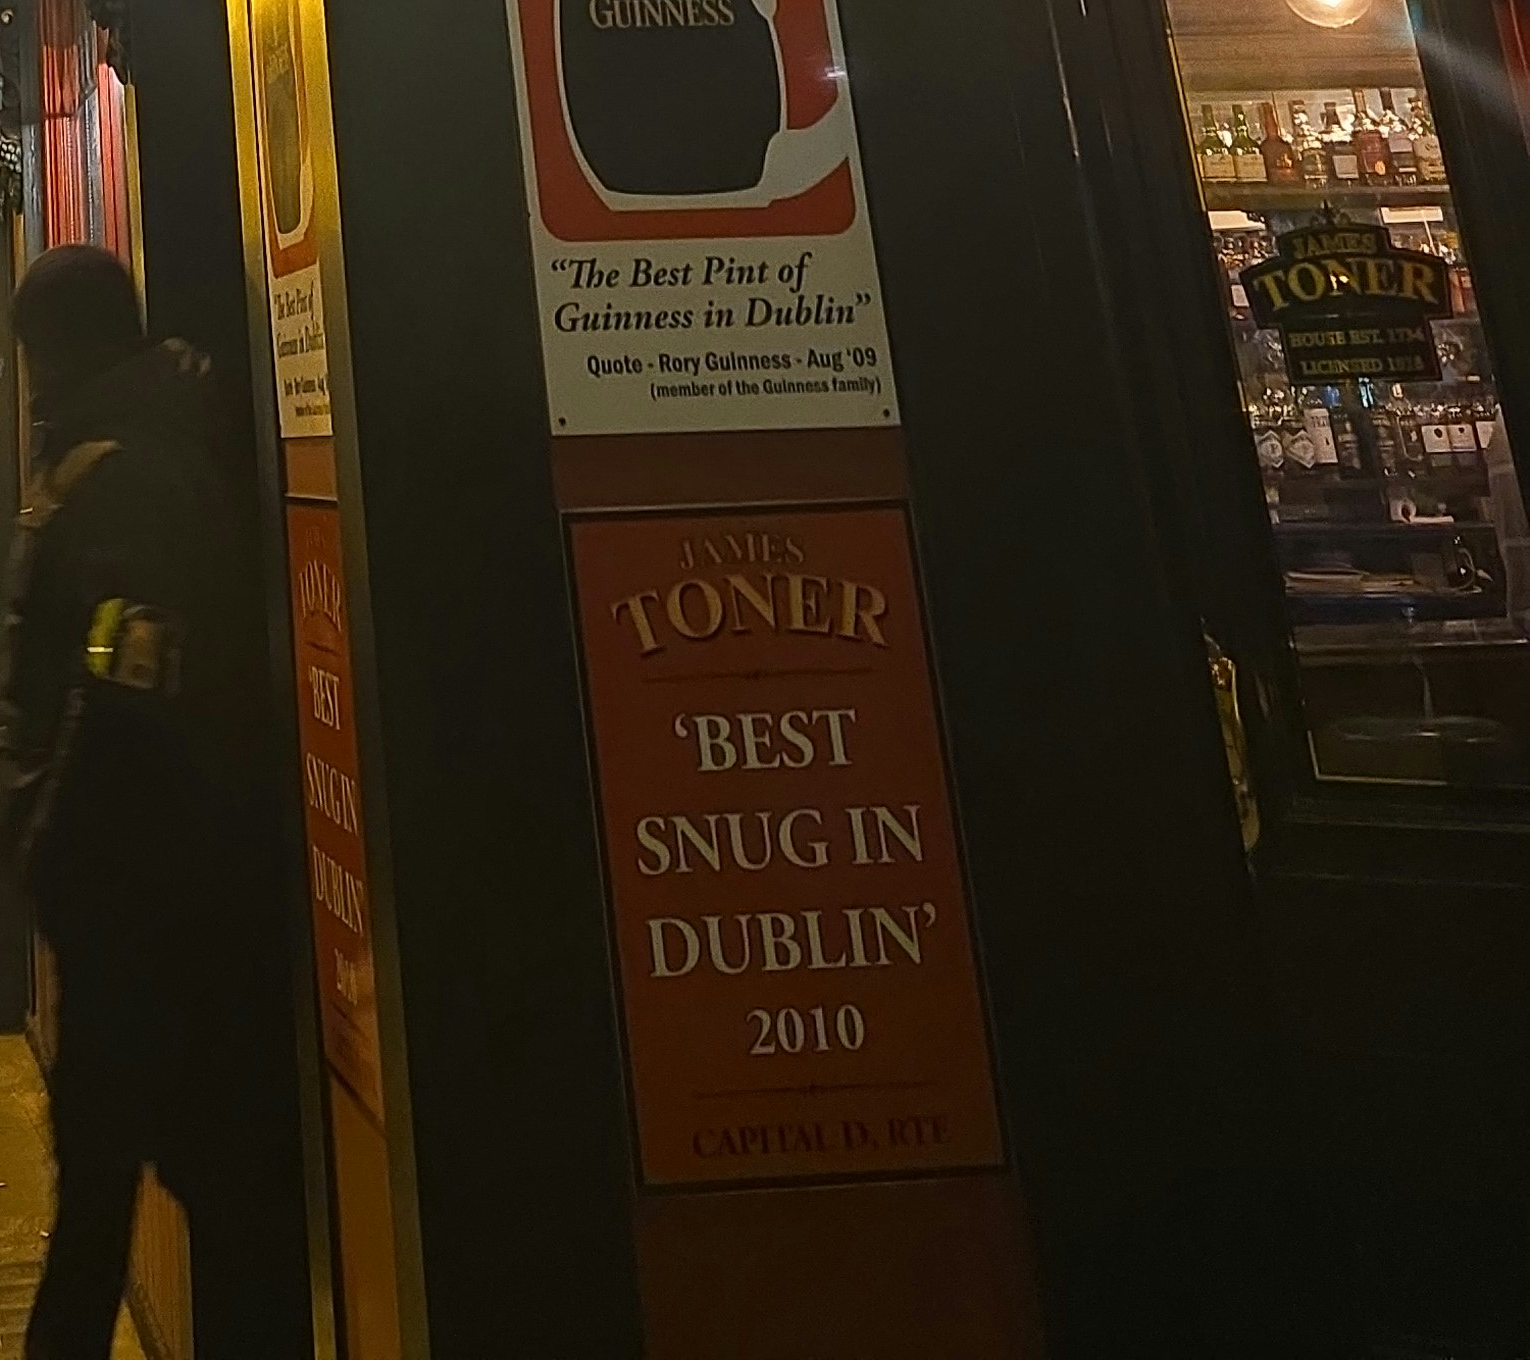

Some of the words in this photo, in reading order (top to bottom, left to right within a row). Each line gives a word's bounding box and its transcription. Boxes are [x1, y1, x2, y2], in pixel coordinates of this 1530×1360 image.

[1292, 232, 1377, 259] JAMES
[629, 257, 694, 288] Best
[701, 255, 769, 286] Pint
[777, 251, 813, 294] of
[1252, 257, 1440, 312] TONER
[553, 300, 695, 333] Guinness
[704, 299, 736, 329] in
[586, 355, 644, 378] Quote
[657, 353, 701, 376] Rory
[704, 349, 792, 372] Guinness
[806, 347, 844, 373] Aug
[650, 381, 716, 402] (member
[718, 380, 734, 397] of
[735, 379, 760, 396] the
[762, 378, 830, 395] Guinness
[831, 375, 882, 395] family)
[678, 530, 806, 570] JAMES
[608, 570, 892, 659] TONER
[634, 806, 832, 877] SNUG
[844, 802, 925, 866] IN
[745, 1003, 866, 1057] 2010
